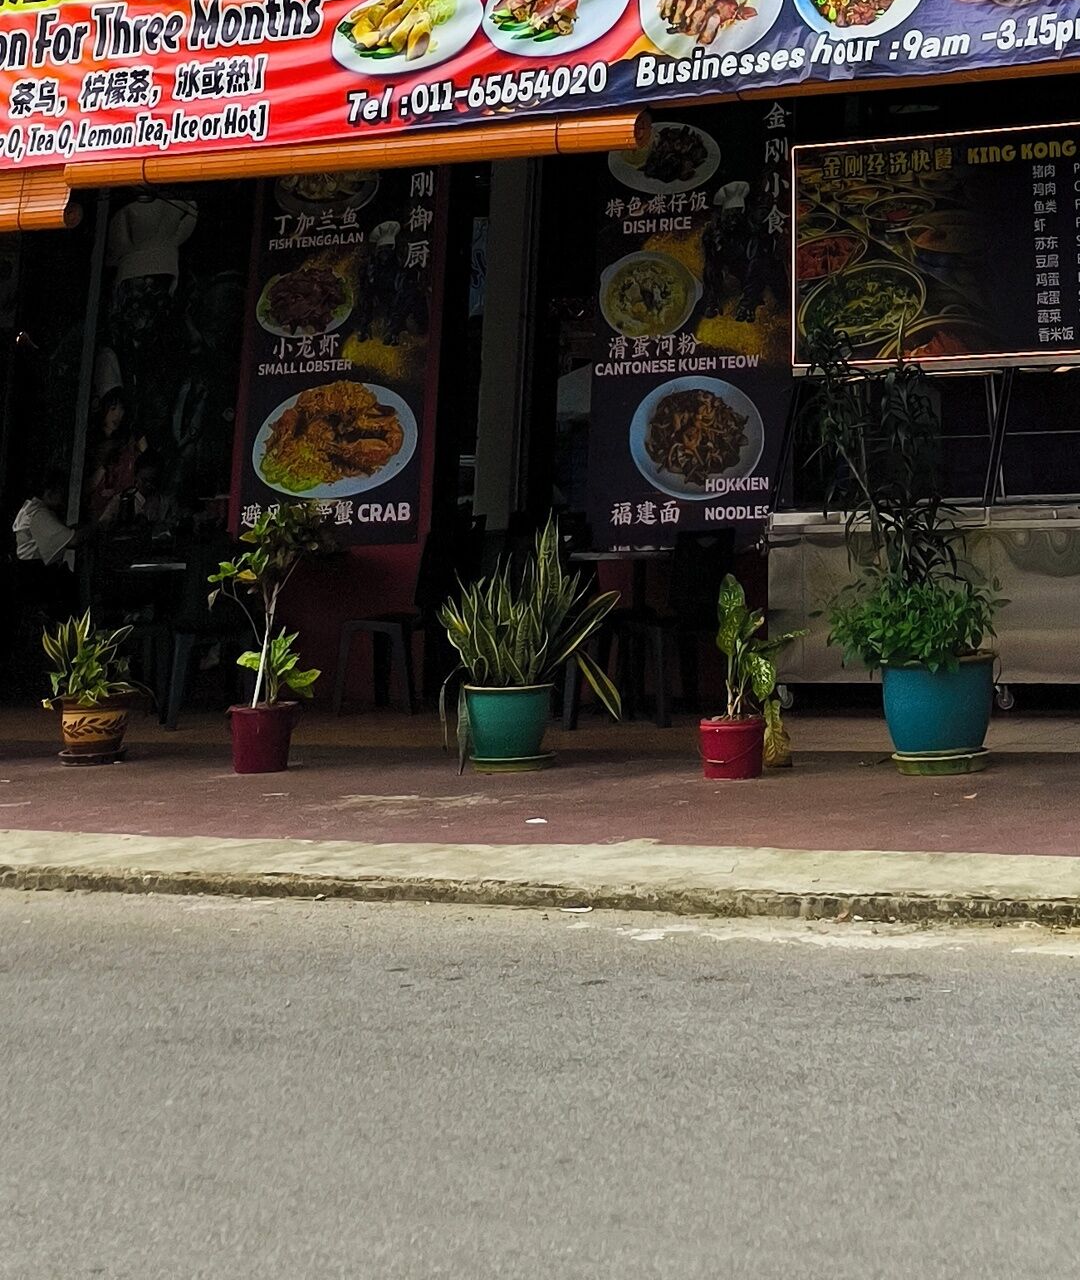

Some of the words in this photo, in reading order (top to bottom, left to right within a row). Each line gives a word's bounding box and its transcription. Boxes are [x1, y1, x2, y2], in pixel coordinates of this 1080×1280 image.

[34, 12, 89, 65] For
[93, 3, 184, 58] Three
[346, 90, 390, 122] Tel
[634, 47, 805, 89] Businesses
[810, 32, 883, 68] hour
[29, 125, 54, 153] Tea
[78, 120, 134, 149] Lemon
[136, 112, 169, 147] Tea,
[173, 110, 198, 140] Ice
[201, 116, 222, 137] or
[967, 144, 1017, 165] KING
[1020, 140, 1077, 160] KONG
[623, 218, 657, 235] DISH
[659, 215, 693, 232] RICE
[268, 236, 294, 252] FISH
[272, 332, 341, 361] 小龙虾
[608, 331, 700, 361] 滑蛋河粉
[257, 359, 298, 377] SMALL
[299, 356, 353, 374] LOBSTER
[594, 358, 677, 378] CANTONESE
[678, 356, 717, 374] KUEH
[719, 353, 760, 371] TEOW
[704, 474, 770, 494] HOKKIEN
[356, 501, 412, 523] CRAB
[609, 500, 682, 526] 福建面
[703, 502, 770, 522] NOODLES
